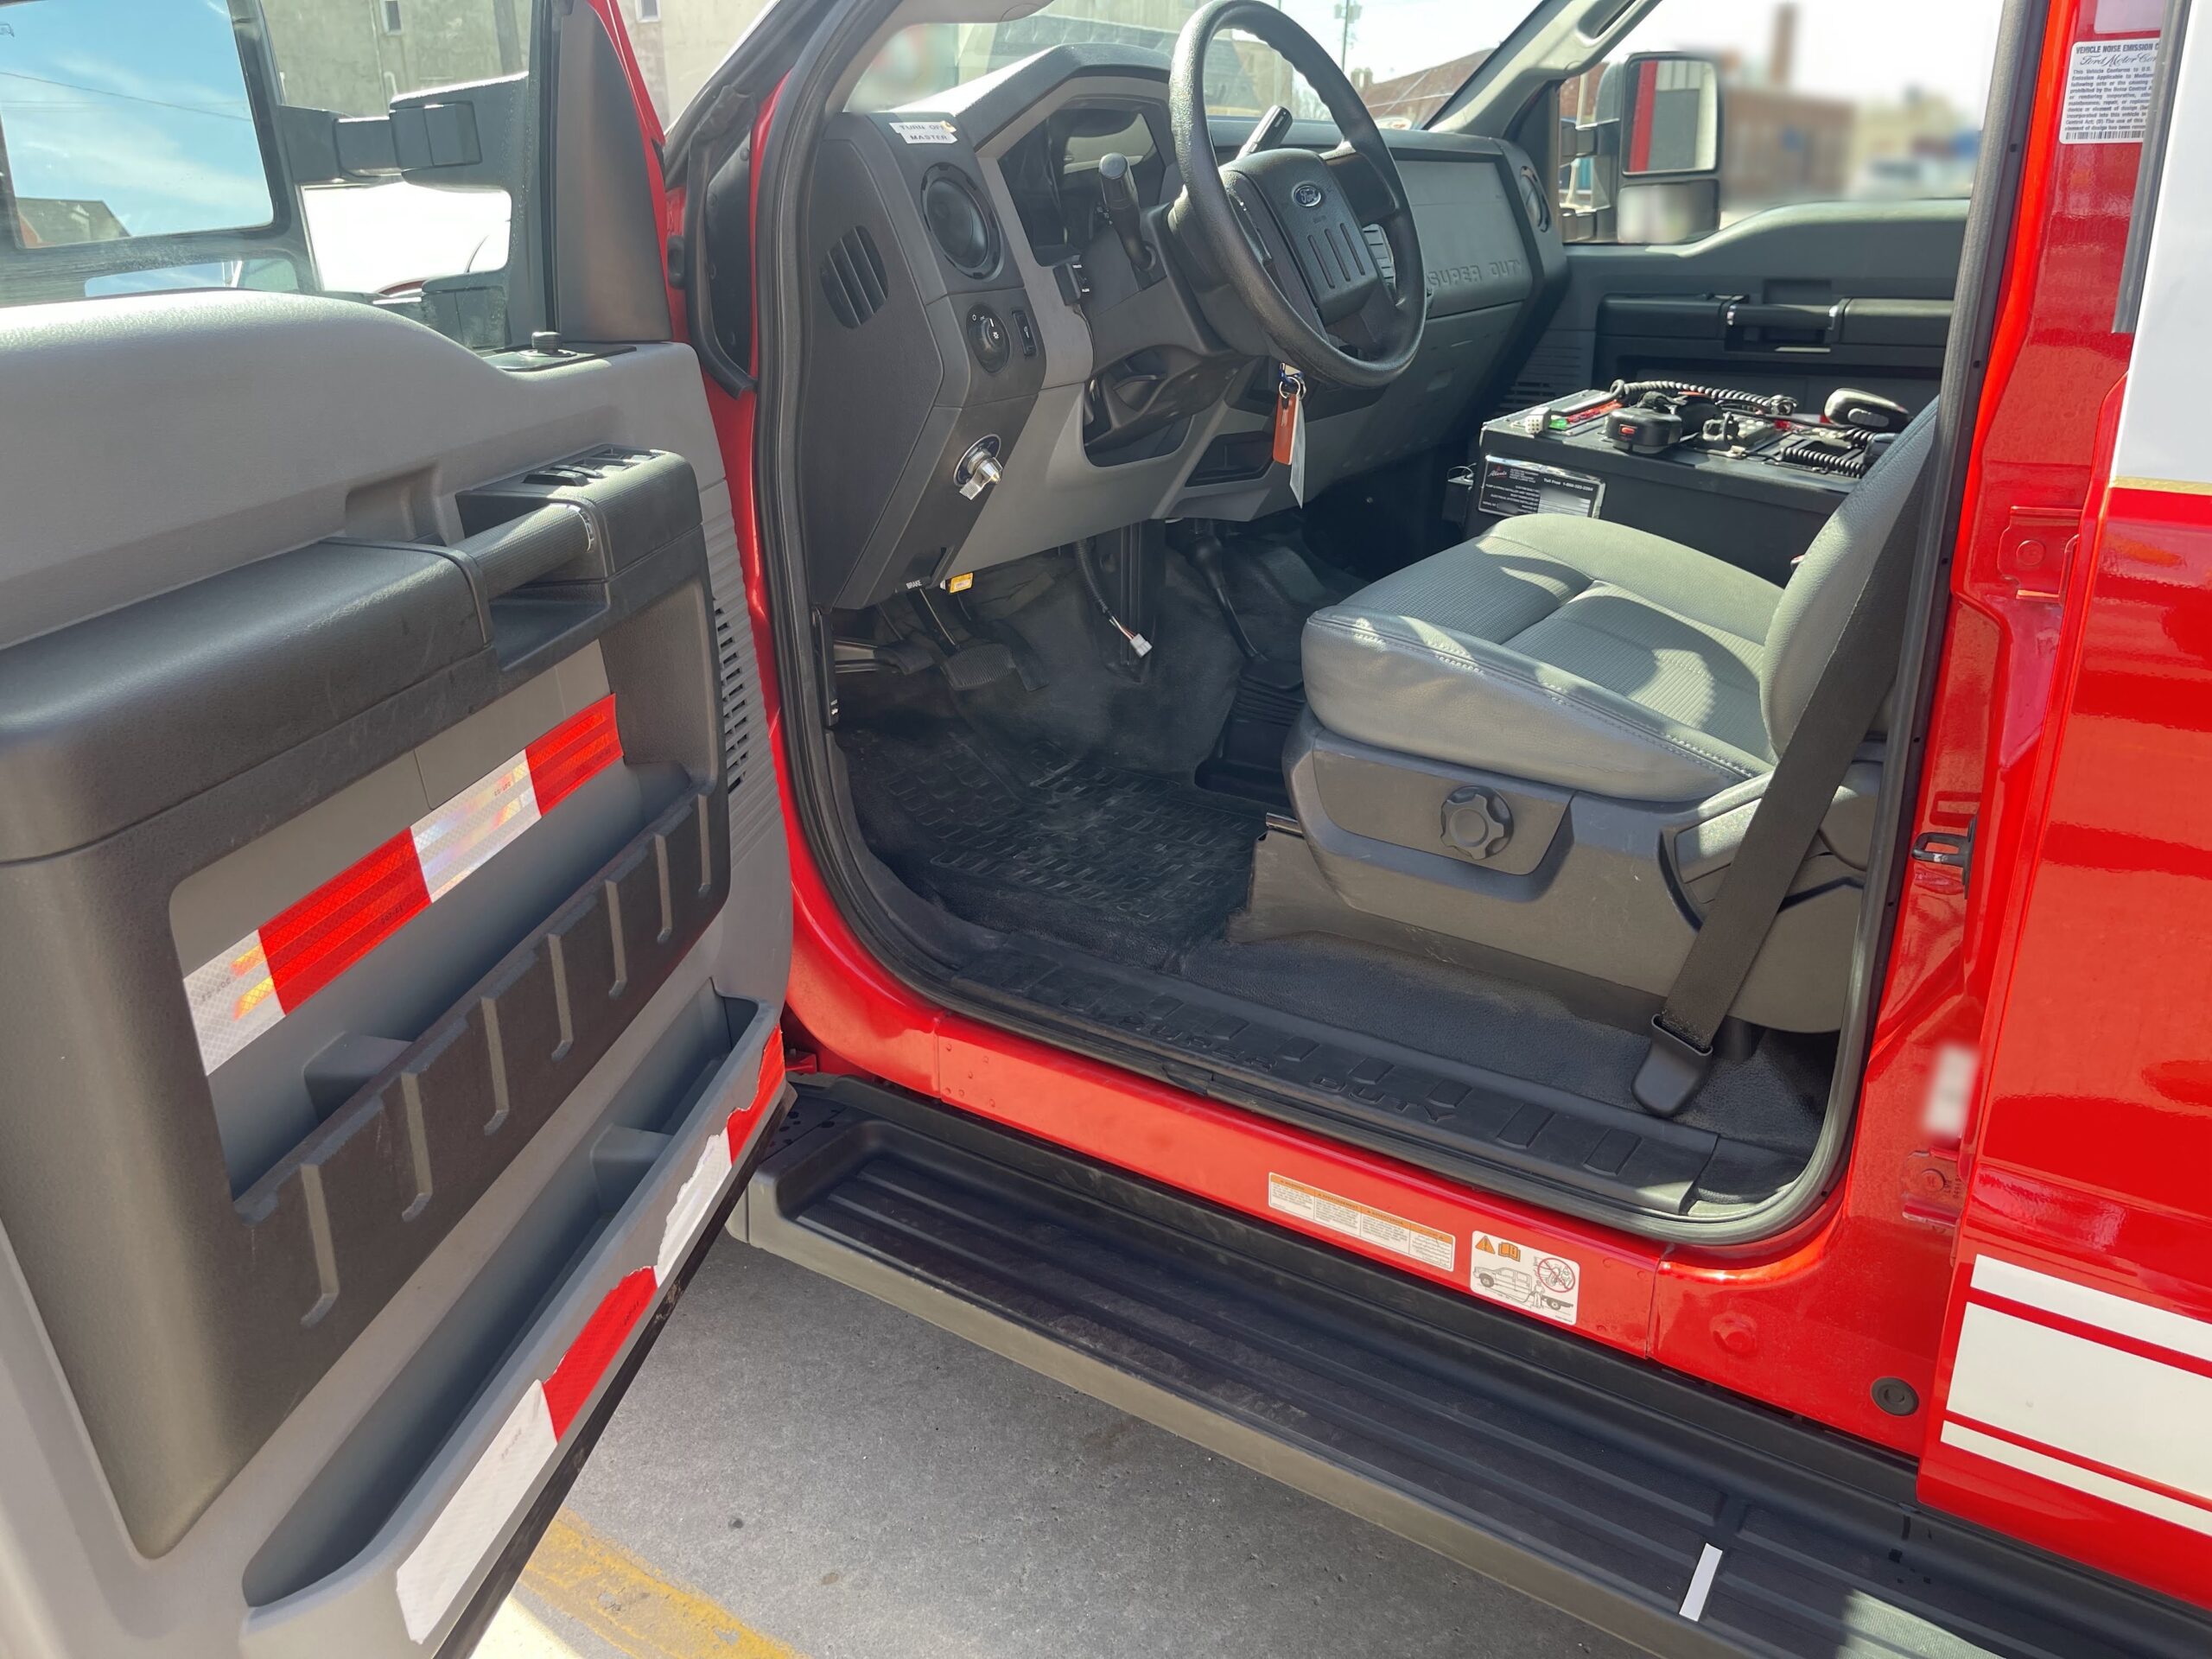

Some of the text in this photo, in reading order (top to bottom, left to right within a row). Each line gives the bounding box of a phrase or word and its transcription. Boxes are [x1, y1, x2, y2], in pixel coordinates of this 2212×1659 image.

[2123, 43, 2153, 52] EMISSION
[2080, 54, 2107, 66] Ford
[2102, 53, 2137, 67] Motor
[1427, 264, 1482, 287] SUPER
[906, 580, 923, 589] BRAKE
